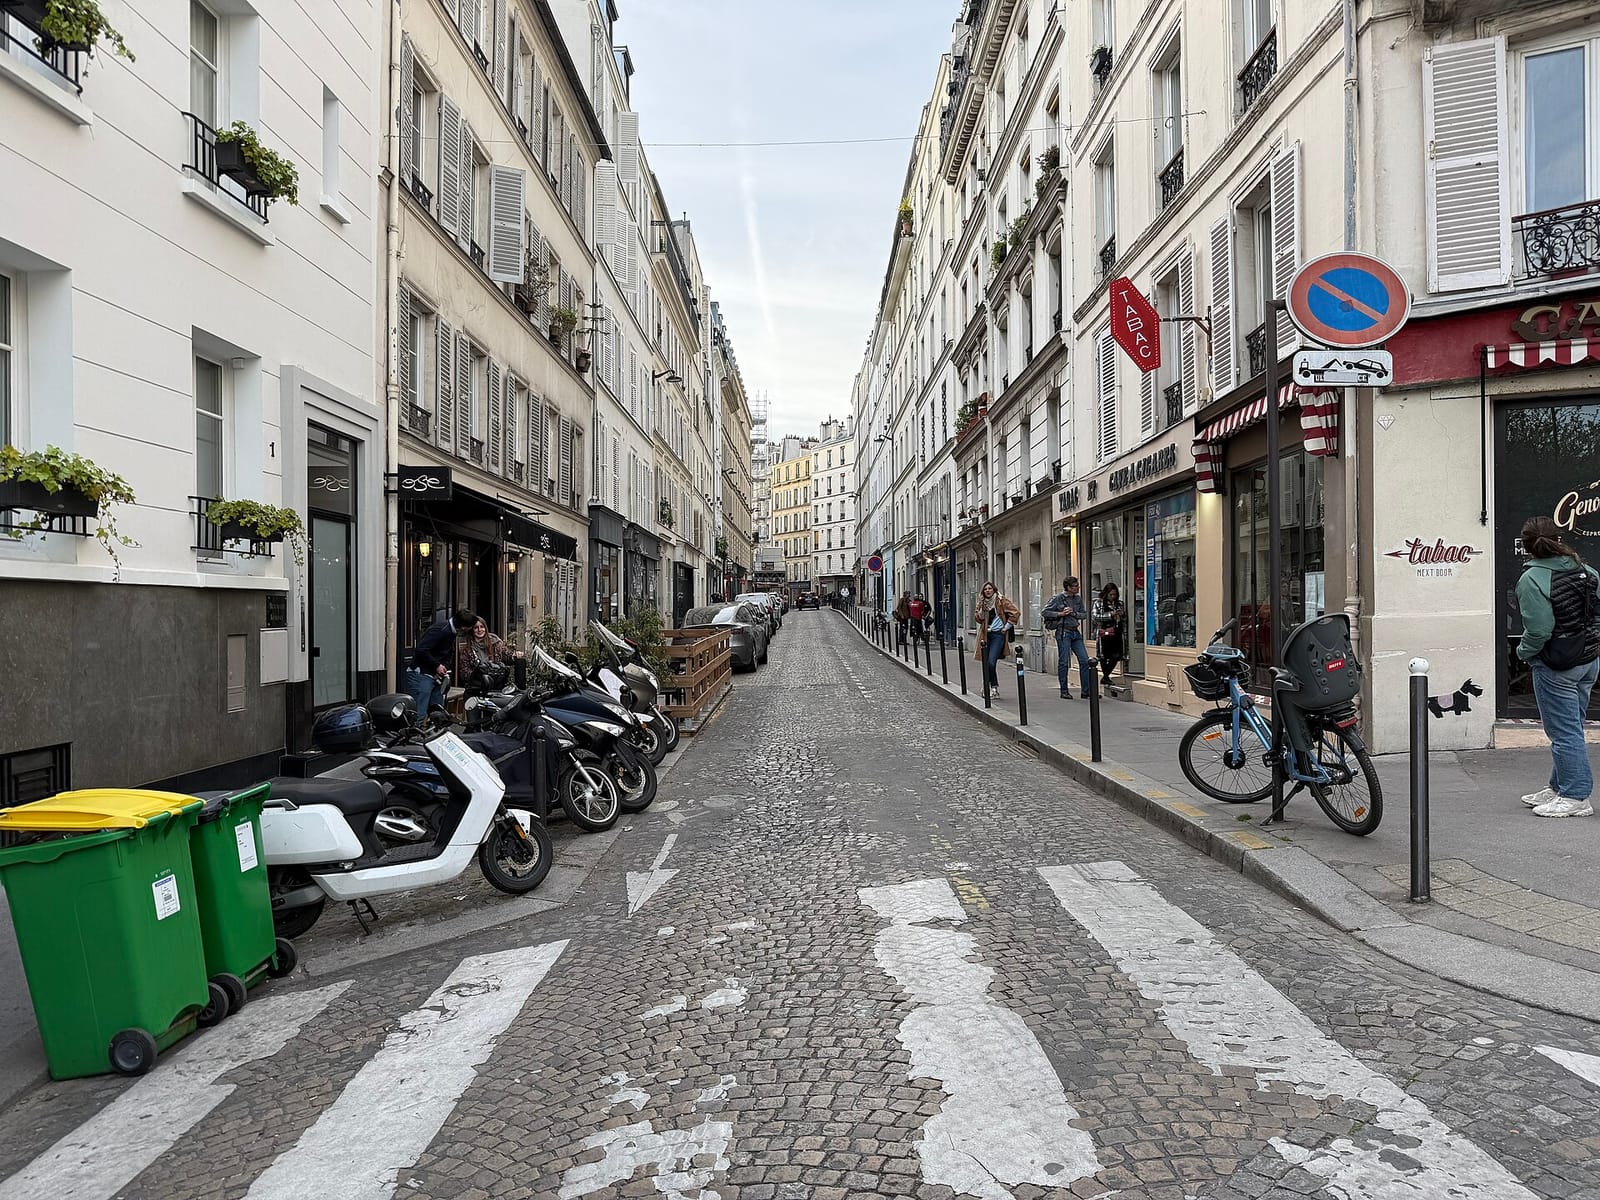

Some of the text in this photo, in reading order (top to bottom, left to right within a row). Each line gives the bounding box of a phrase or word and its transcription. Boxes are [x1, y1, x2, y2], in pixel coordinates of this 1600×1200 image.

[1119, 290, 1151, 358] TABAC
[269, 441, 275, 458] 1
[1058, 486, 1079, 512] TABAC
[1087, 480, 1097, 501] ET
[1109, 466, 1129, 492] CAVE
[1136, 443, 1176, 481] CIGARES
[1405, 537, 1474, 565] tabac
[1417, 568, 1453, 577] NEXT DOOR
